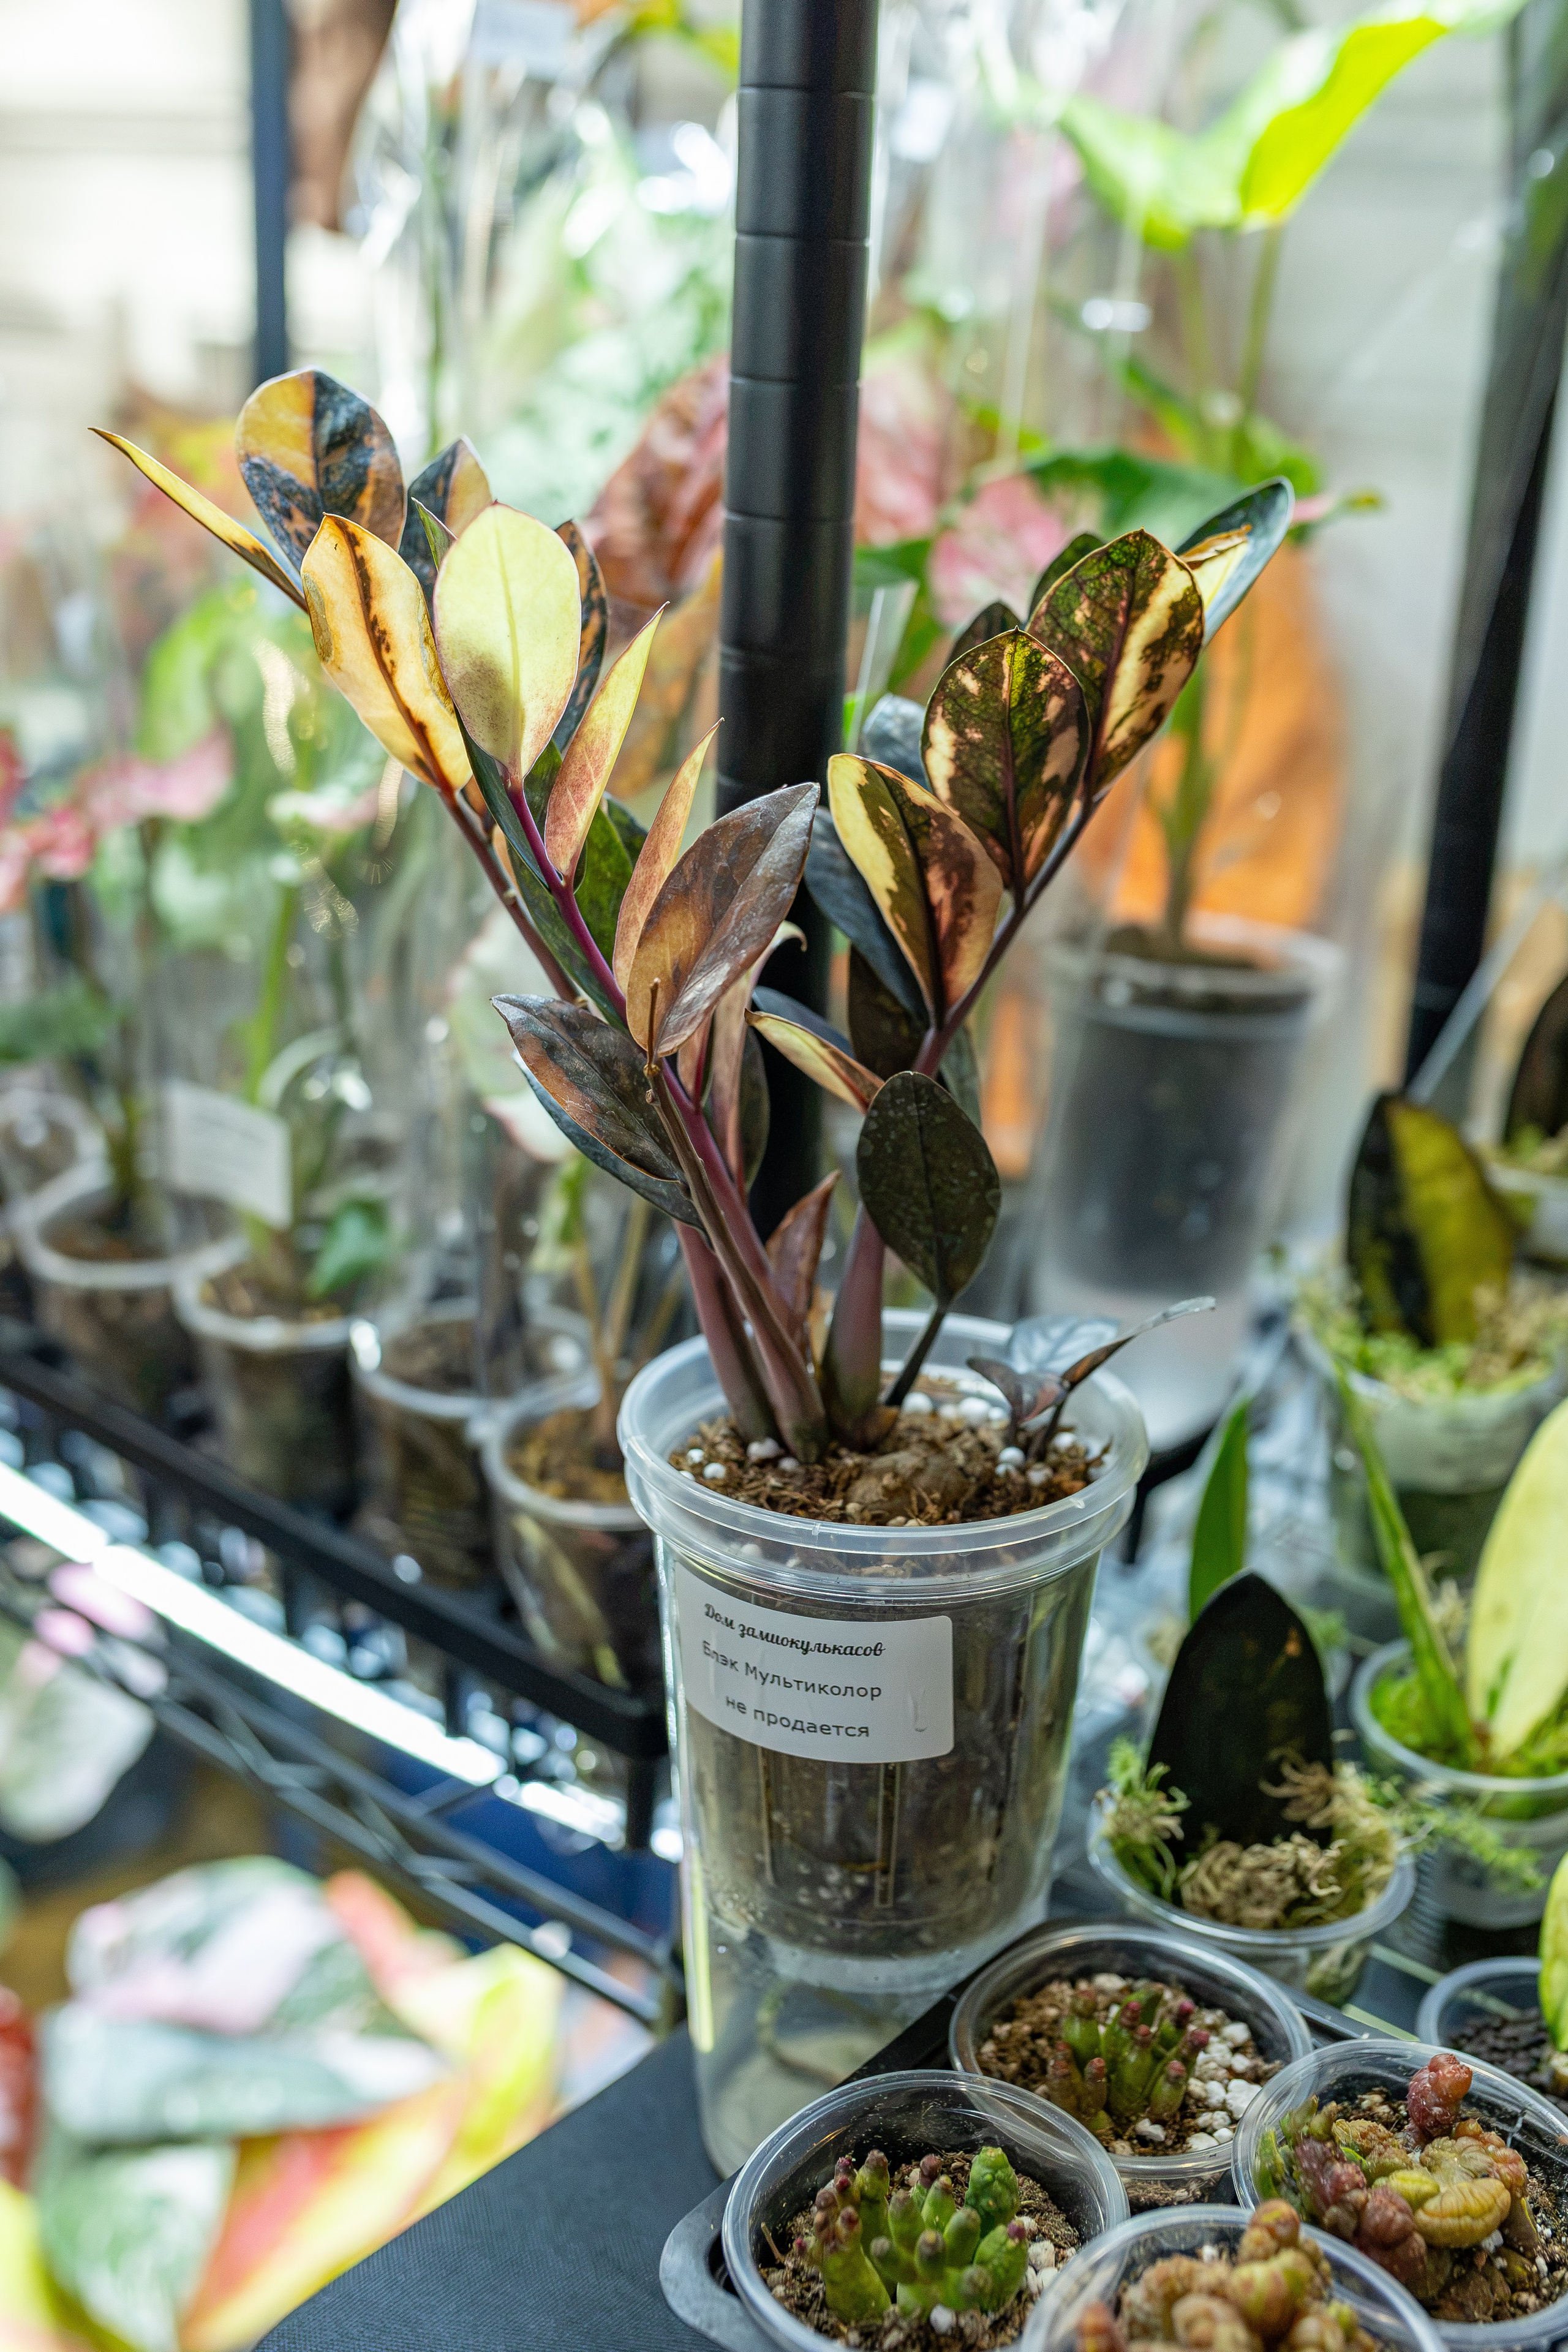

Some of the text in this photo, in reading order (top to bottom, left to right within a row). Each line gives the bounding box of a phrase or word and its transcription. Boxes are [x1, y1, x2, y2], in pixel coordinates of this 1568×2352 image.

[704, 1603, 735, 1630] Дом
[745, 1662, 881, 1701] Мультиколор
[726, 1695, 870, 1737] не продается
